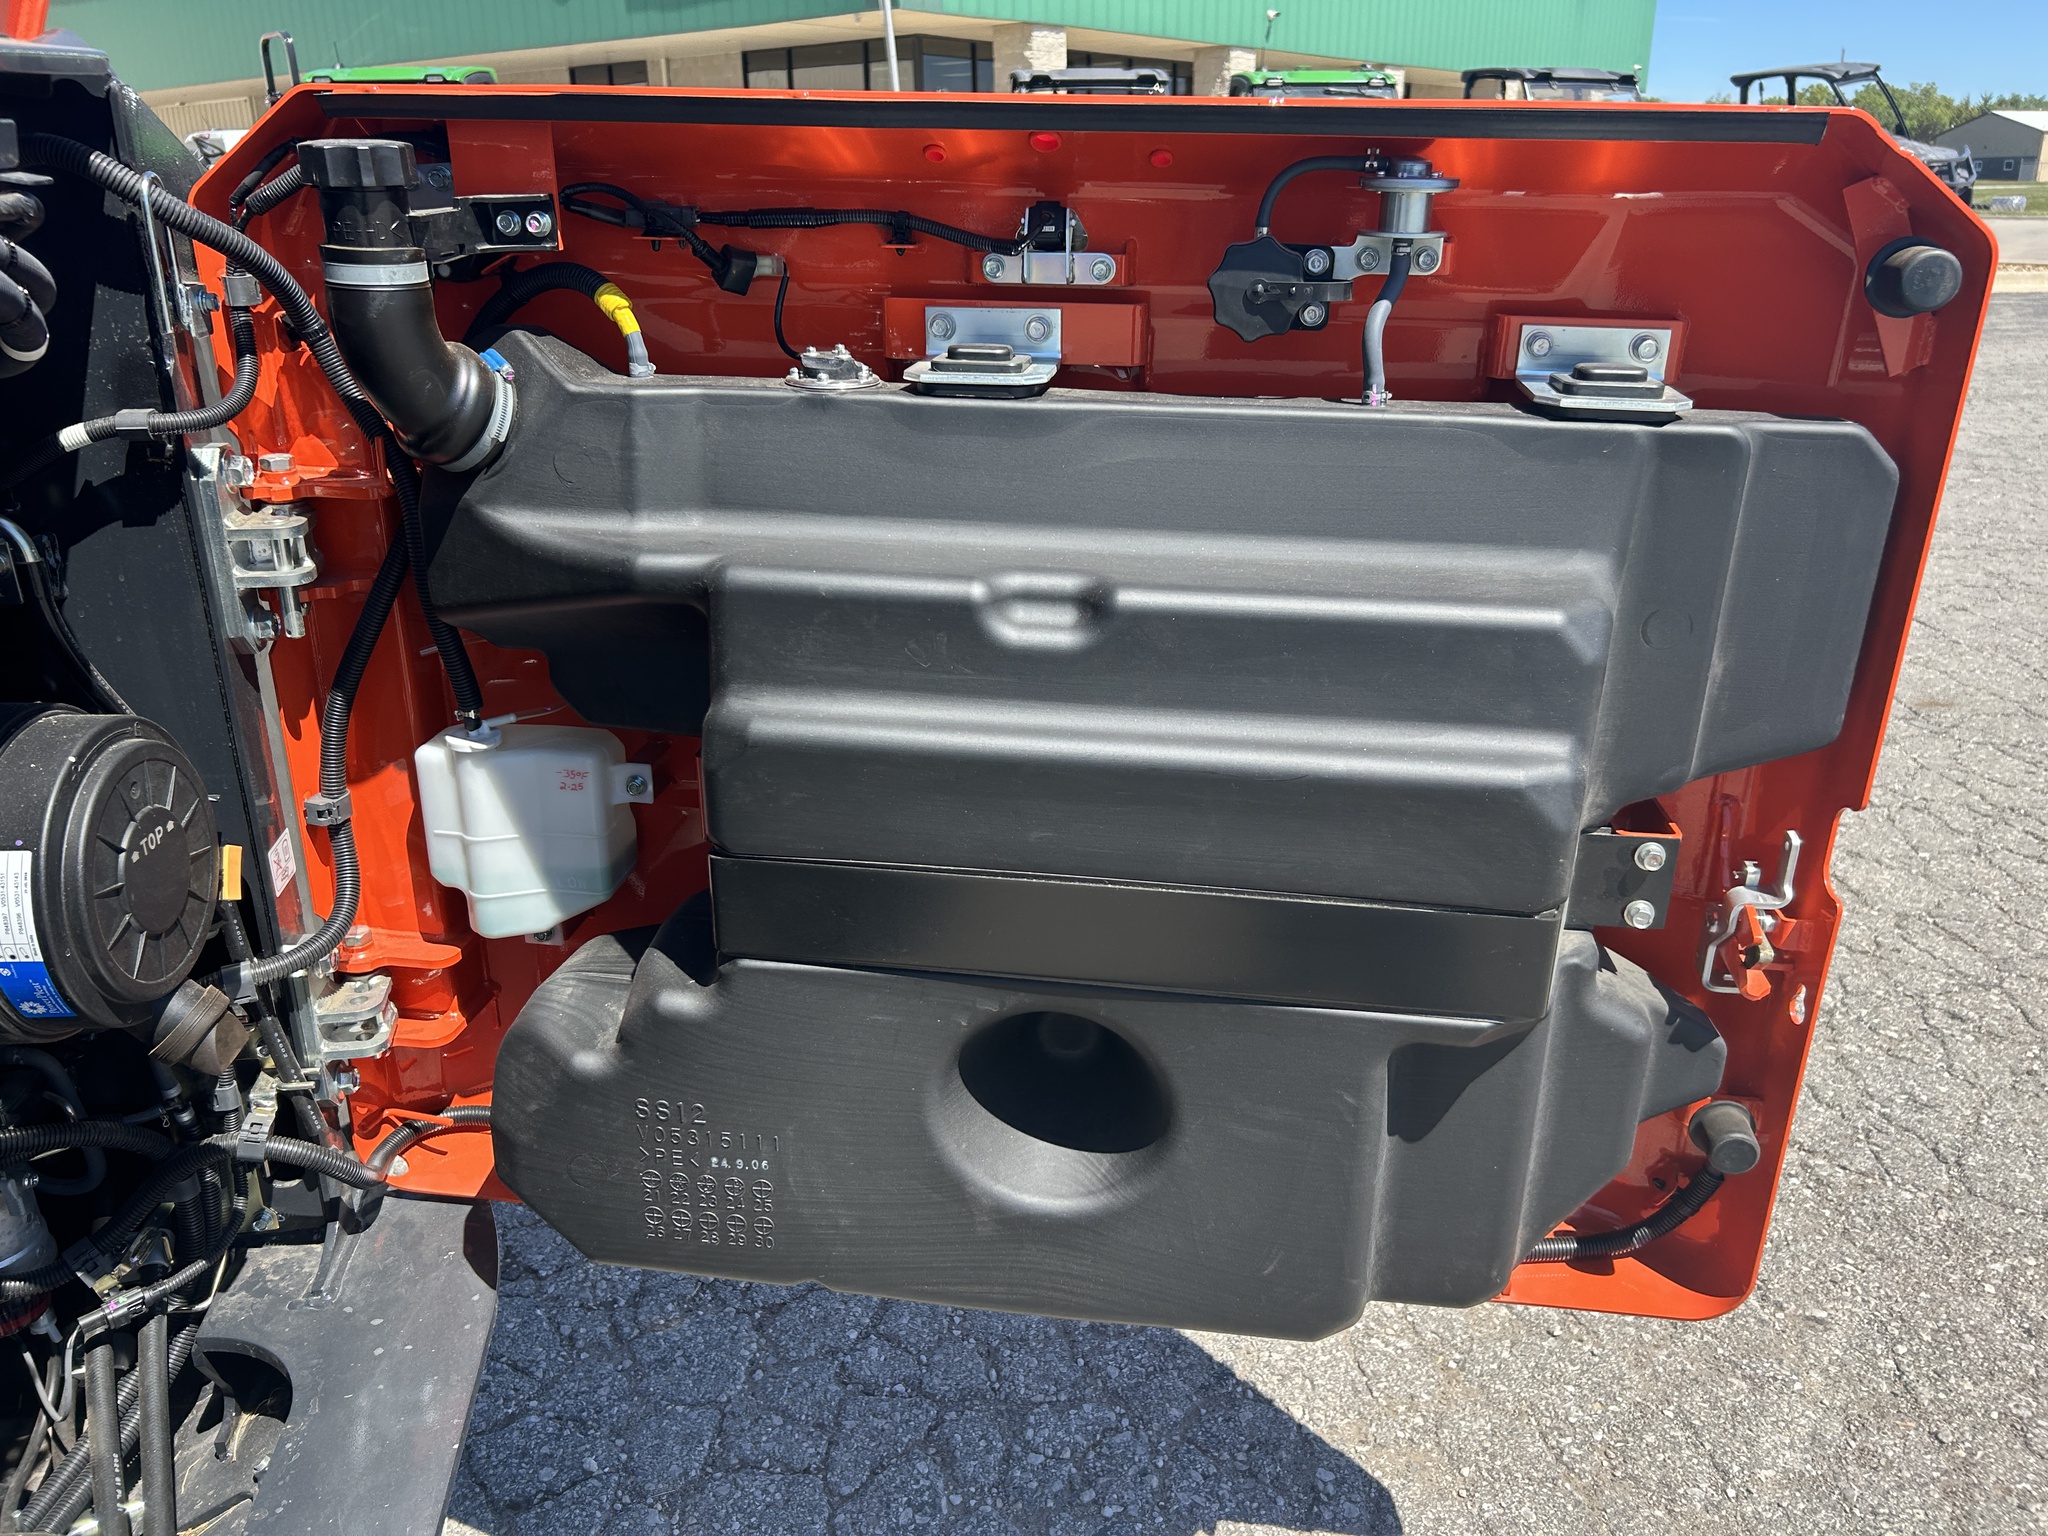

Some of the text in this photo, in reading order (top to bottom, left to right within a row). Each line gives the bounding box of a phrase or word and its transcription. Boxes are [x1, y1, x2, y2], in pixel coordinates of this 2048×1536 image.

[140, 825, 163, 855] TOP
[634, 1097, 707, 1124] SS12
[636, 1123, 780, 1152] V05315111
[643, 1189, 774, 1213] 21 22 23 24 25
[645, 1224, 775, 1249] 26 27 28 29 30
